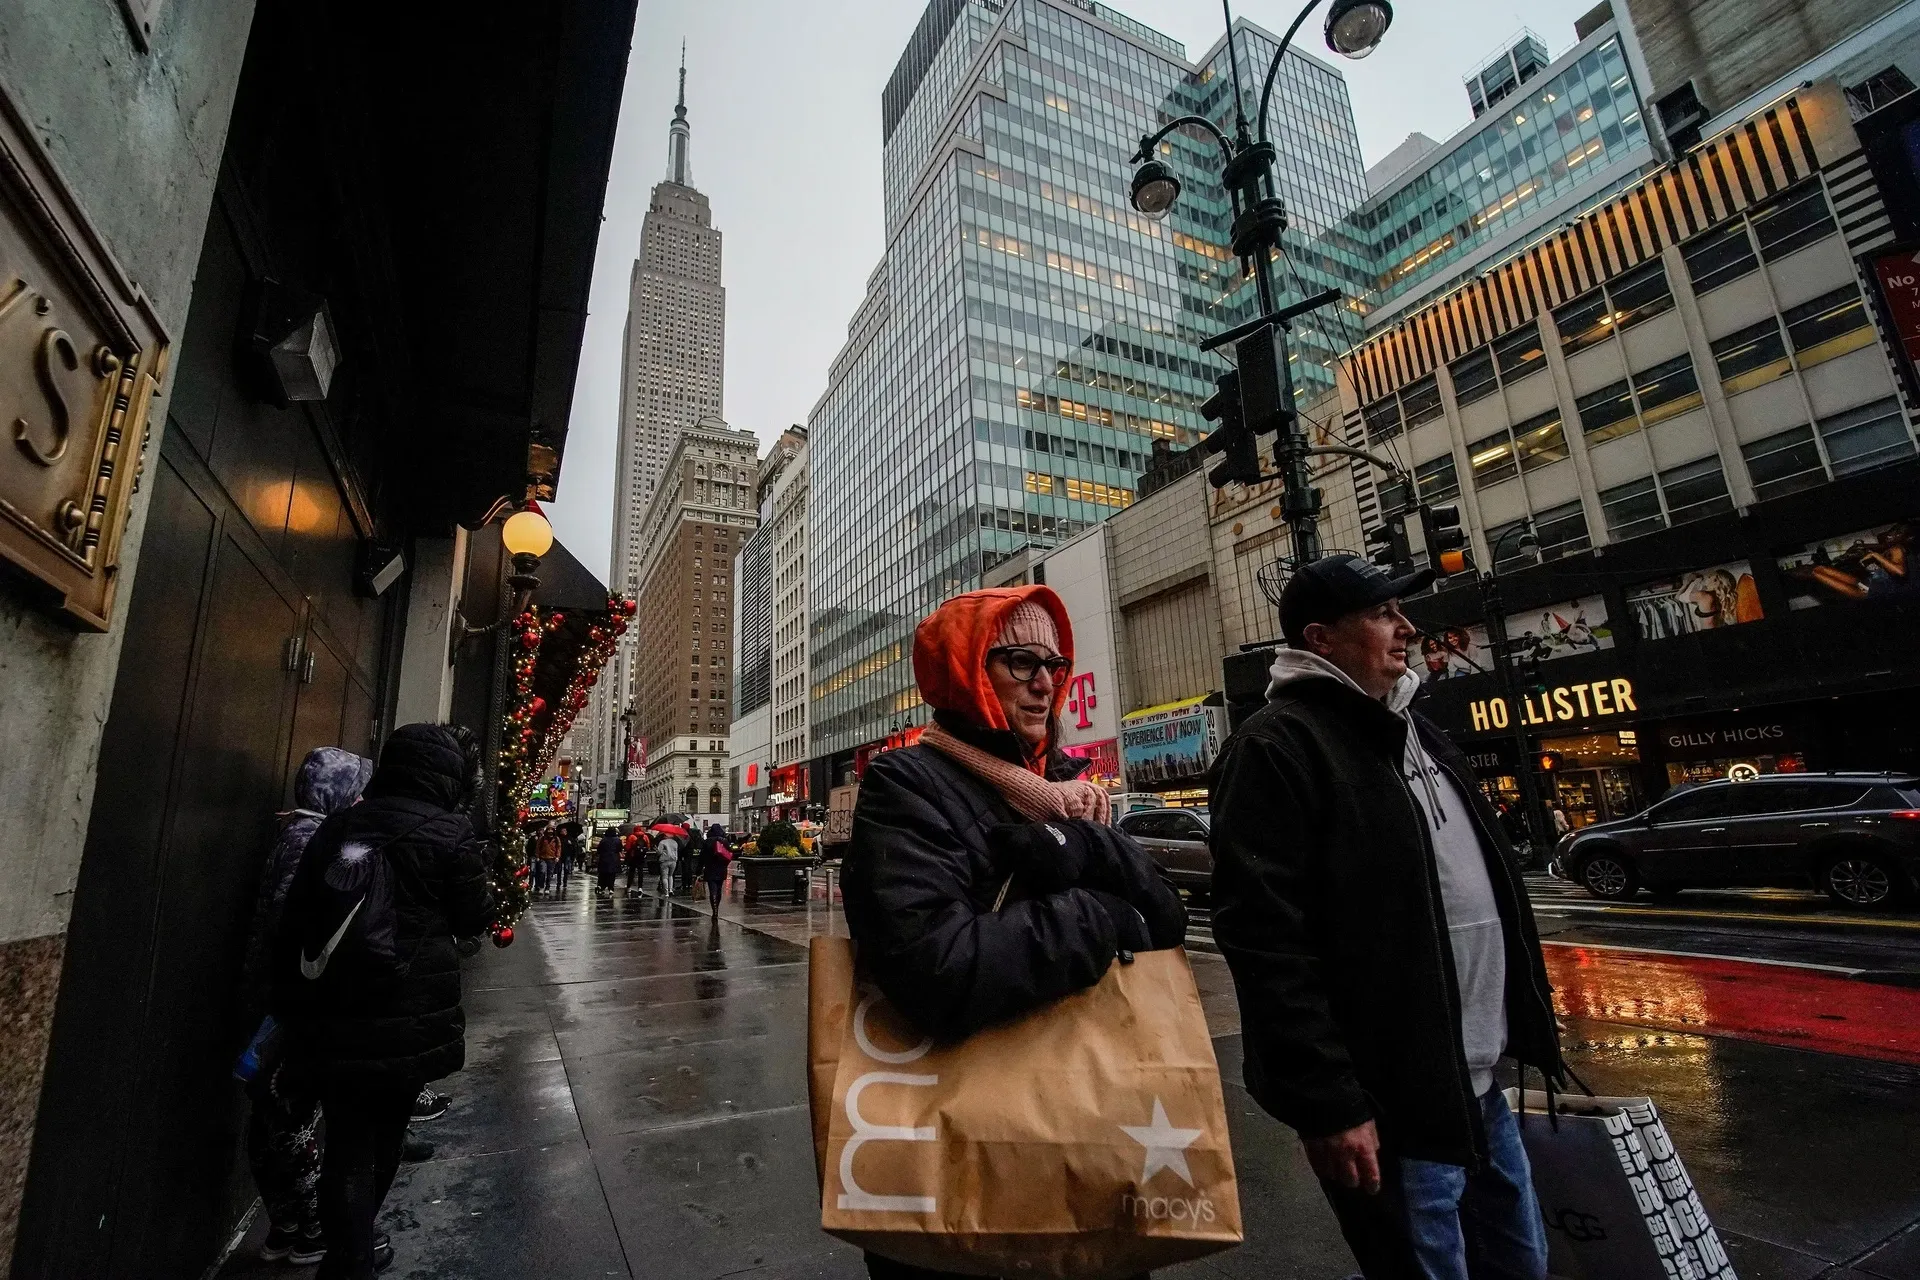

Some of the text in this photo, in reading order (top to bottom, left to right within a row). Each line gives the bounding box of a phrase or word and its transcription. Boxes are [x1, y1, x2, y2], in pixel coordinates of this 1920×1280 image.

[1069, 672, 1096, 729] T
[1206, 709, 1215, 729] 30
[1123, 726, 1164, 748] EXPERIENCE
[1165, 720, 1179, 741] NY
[1669, 725, 1784, 747] GILLY HICKS
[1089, 756, 1118, 775] Mobile
[1467, 753, 1499, 768] STER
[1653, 1158, 1680, 1181] UGG
[1122, 1189, 1216, 1230] macy's
